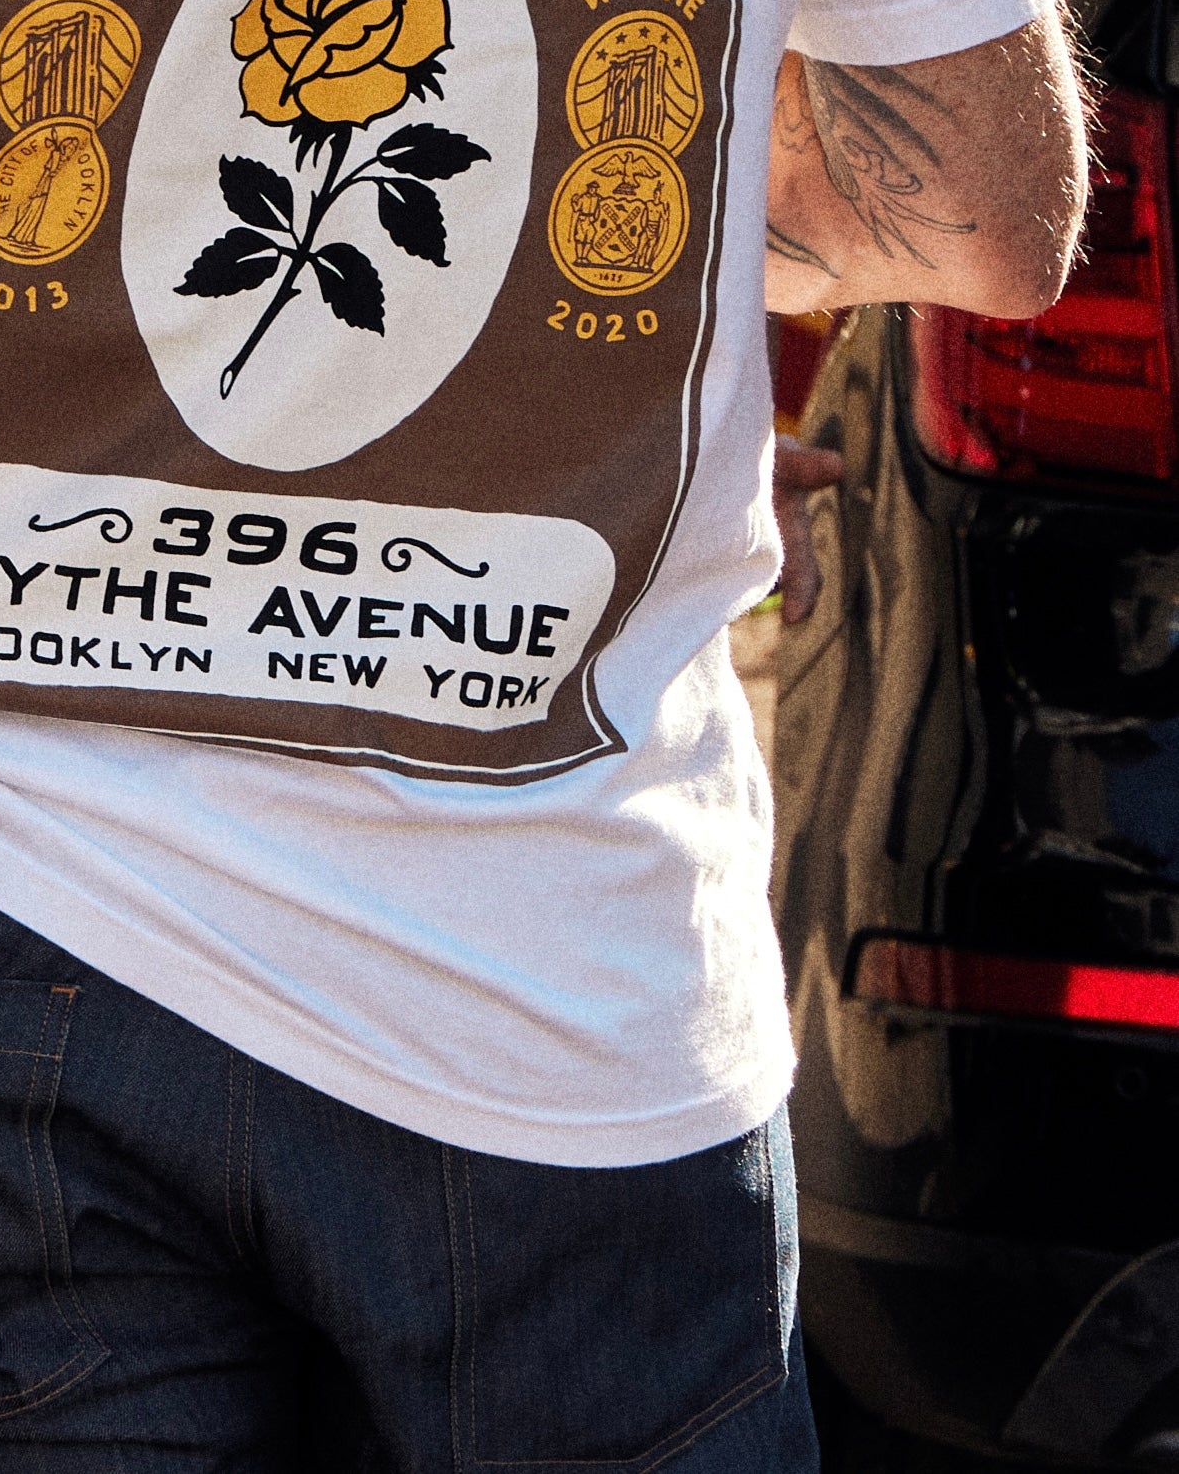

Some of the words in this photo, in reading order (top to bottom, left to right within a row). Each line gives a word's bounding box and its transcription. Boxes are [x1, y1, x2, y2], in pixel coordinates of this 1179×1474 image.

[0, 156, 22, 186] CITY
[20, 139, 38, 156] OF
[63, 138, 94, 231] OOKLYN
[547, 300, 658, 342] 2020
[153, 508, 358, 575] 396
[248, 586, 569, 657] AVENUE
[268, 651, 387, 689] NEW
[423, 668, 550, 710] YORK
